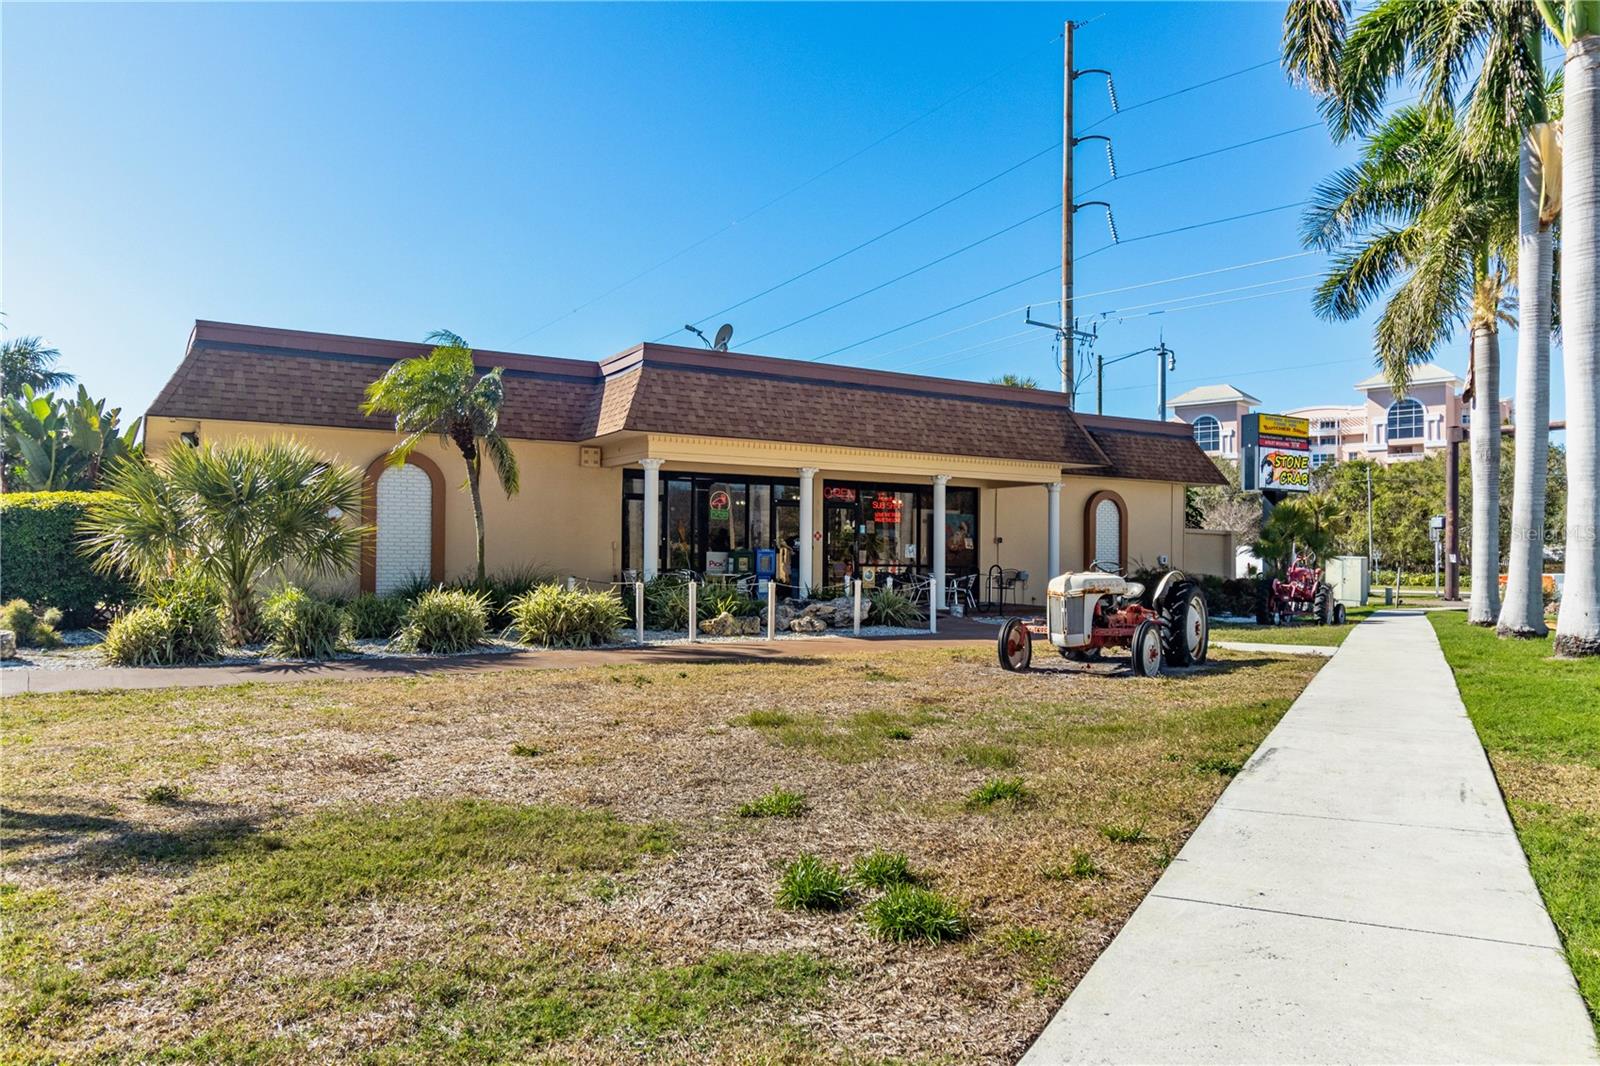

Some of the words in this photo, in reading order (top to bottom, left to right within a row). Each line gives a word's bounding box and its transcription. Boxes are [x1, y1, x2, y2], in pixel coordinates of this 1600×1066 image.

[1275, 455, 1309, 469] STONE
[1280, 470, 1309, 485] CRAB
[824, 487, 856, 502] OPEN
